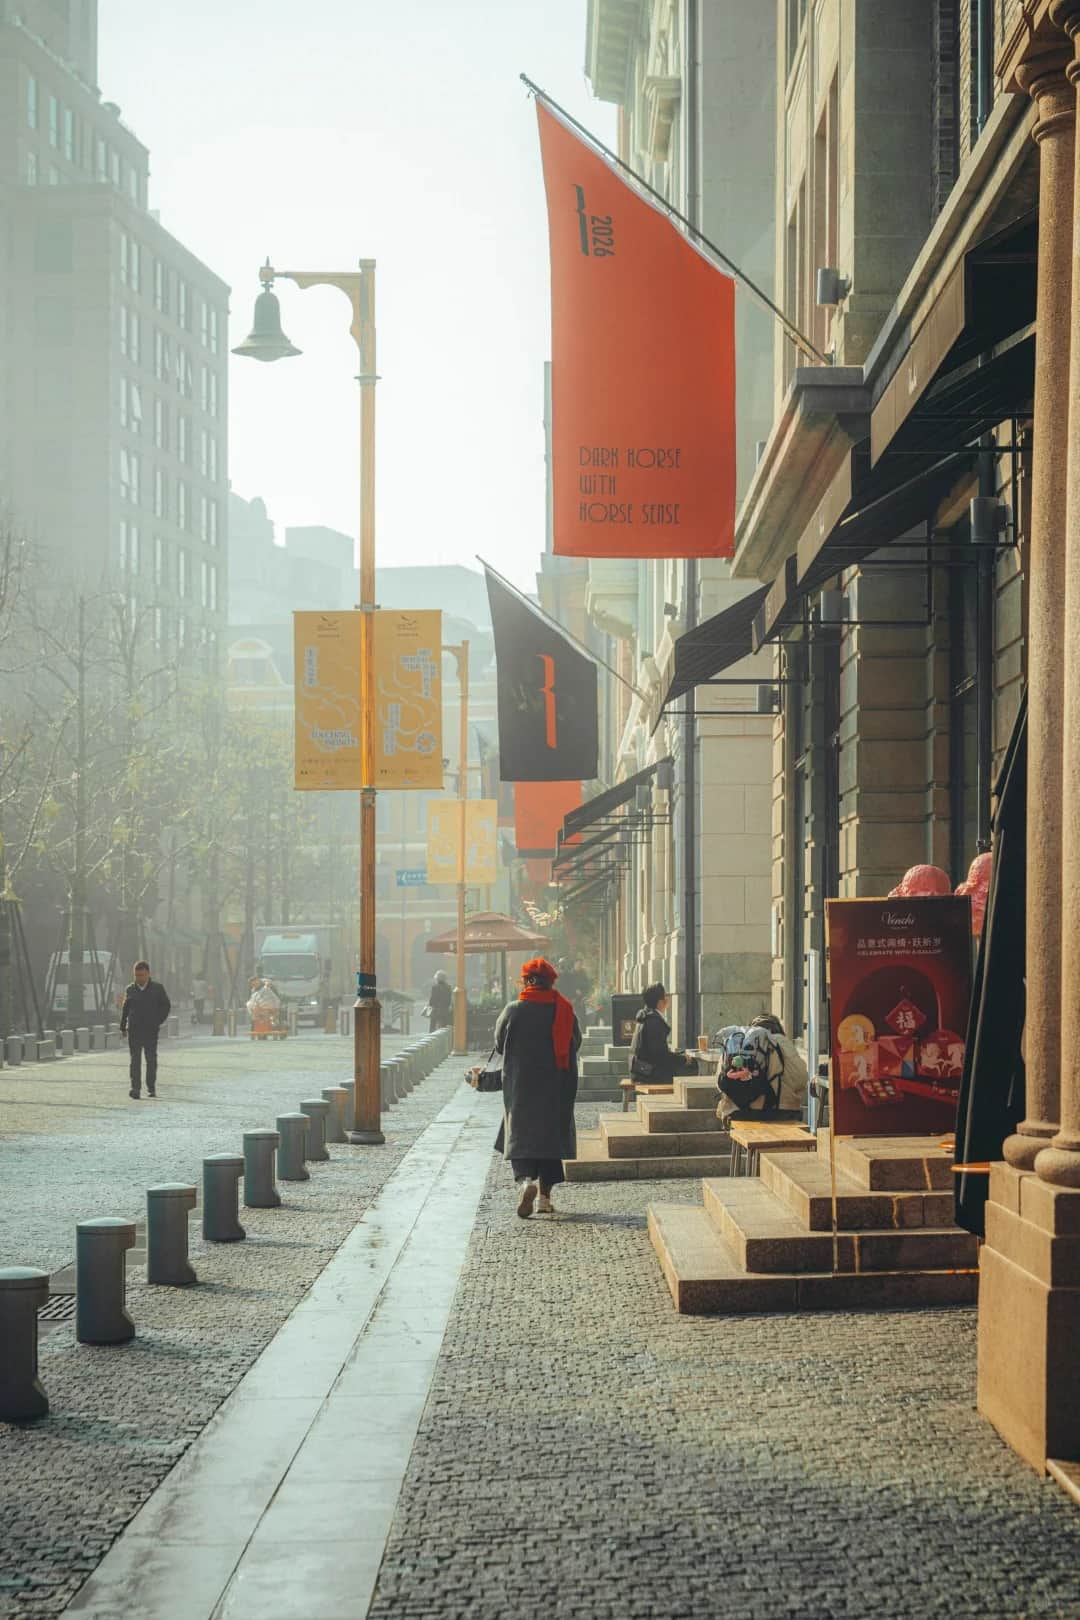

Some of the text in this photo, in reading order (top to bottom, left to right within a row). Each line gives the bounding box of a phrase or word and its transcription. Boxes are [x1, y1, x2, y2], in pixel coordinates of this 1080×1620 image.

[591, 216, 615, 257] 2026
[579, 446, 681, 469] DARK HORSE
[579, 502, 681, 525] HORSE SENSE
[895, 1011, 916, 1030] 福
